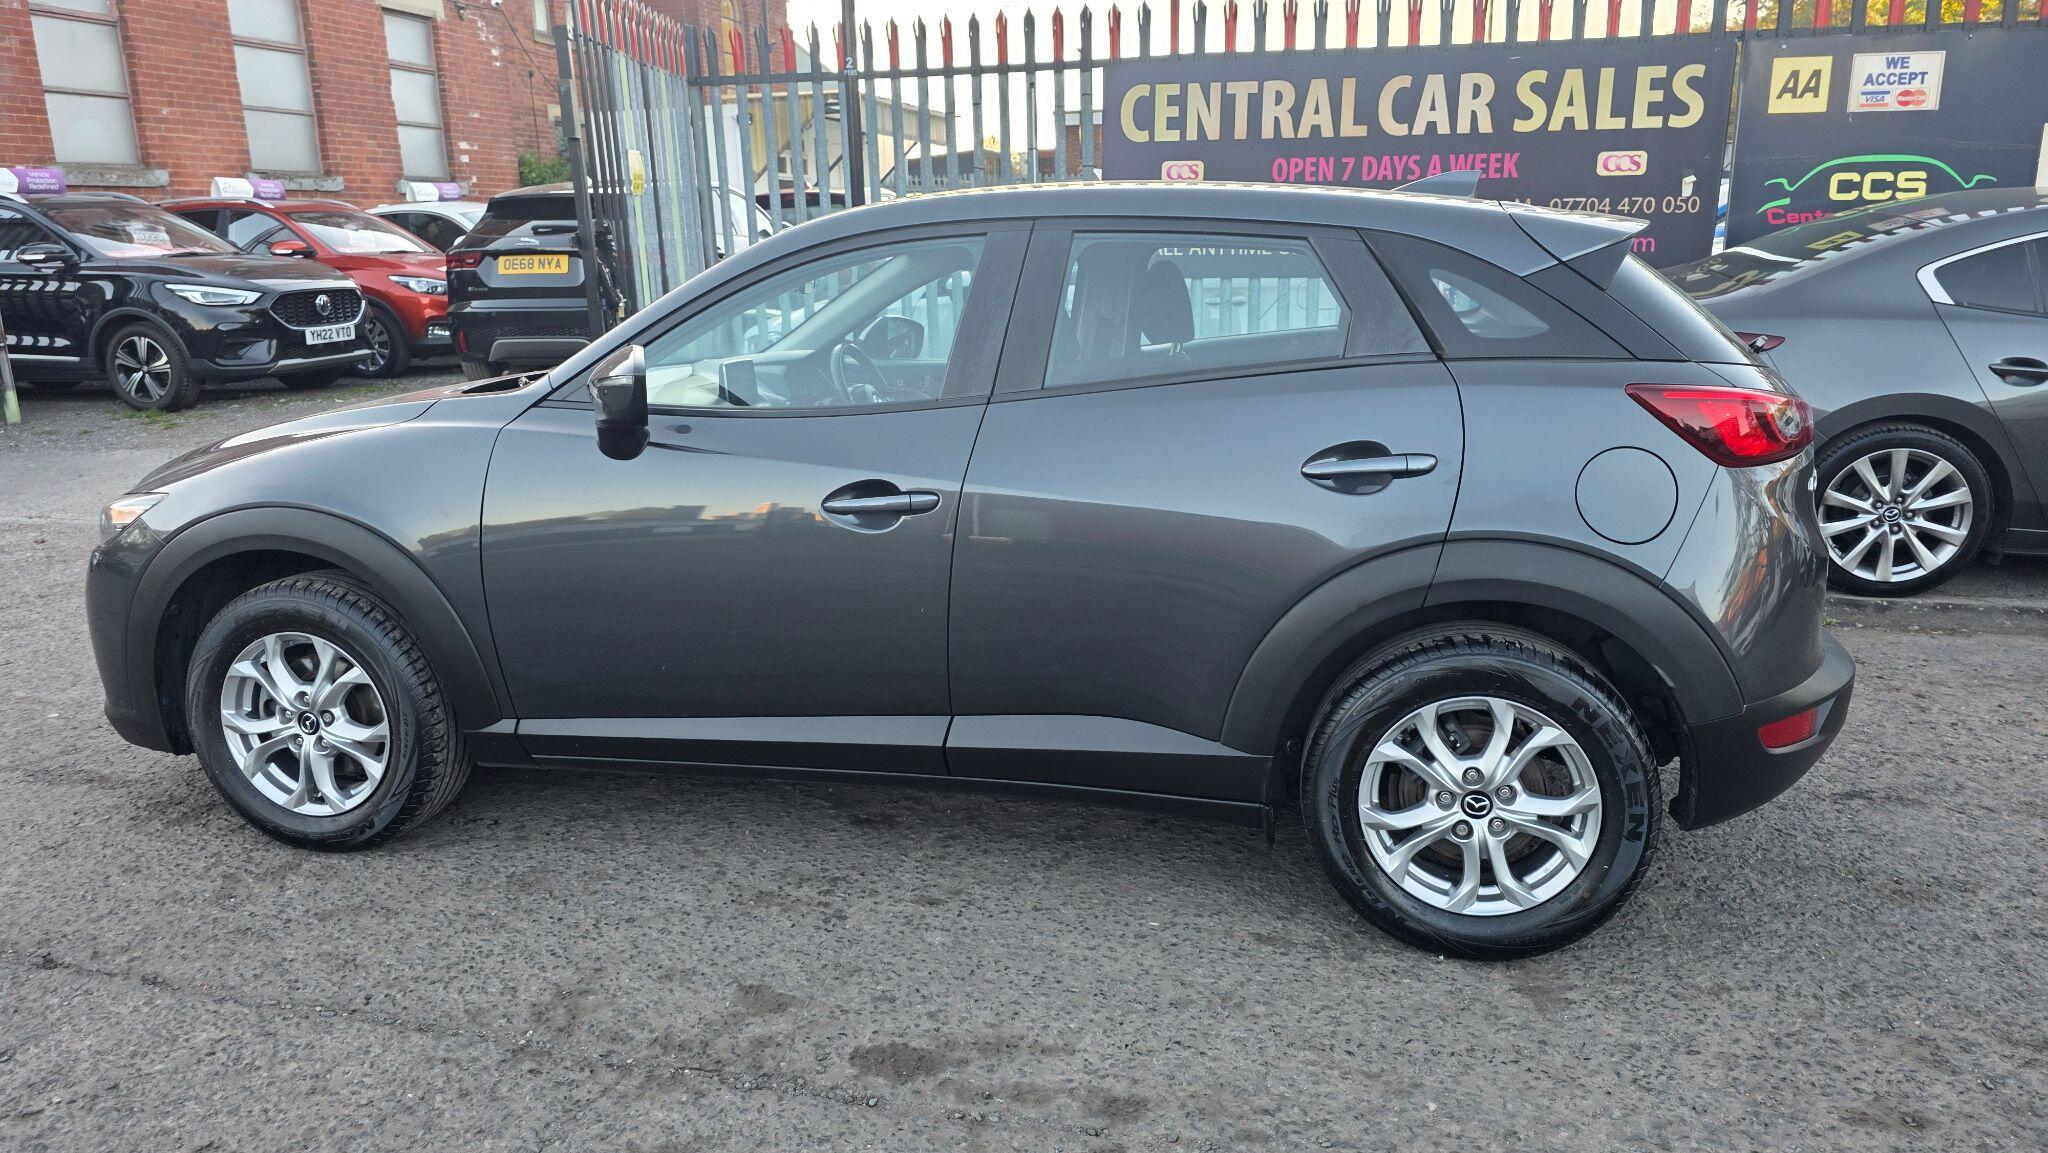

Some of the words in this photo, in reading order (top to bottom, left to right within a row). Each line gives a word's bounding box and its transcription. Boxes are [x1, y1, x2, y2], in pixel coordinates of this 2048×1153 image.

[845, 56, 854, 69] 2
[1885, 56, 1910, 70] WE
[1775, 69, 1822, 99] AA
[1863, 71, 1928, 86] ACCEPT
[1120, 78, 1368, 143] CENTRAL
[1377, 72, 1496, 137] CAR
[1512, 63, 1707, 133] SALES
[1865, 95, 1885, 103] VISA
[1166, 164, 1200, 180] CCS
[1271, 156, 1335, 183] OPEN
[1341, 156, 1356, 182] 7
[1361, 154, 1421, 181] DAYS
[1427, 154, 1442, 176] A
[1449, 152, 1520, 179] WEEK
[1602, 154, 1642, 173] CCS
[1828, 170, 1928, 201] CCS
[1549, 197, 1612, 214] 07704
[1616, 196, 1656, 214] 470
[1662, 196, 1701, 214] 050
[503, 258, 535, 270] OE68
[538, 257, 561, 270] NYA
[310, 328, 334, 341] YH22
[335, 326, 352, 339] VTO
[1571, 697, 1645, 842] NEXEN
